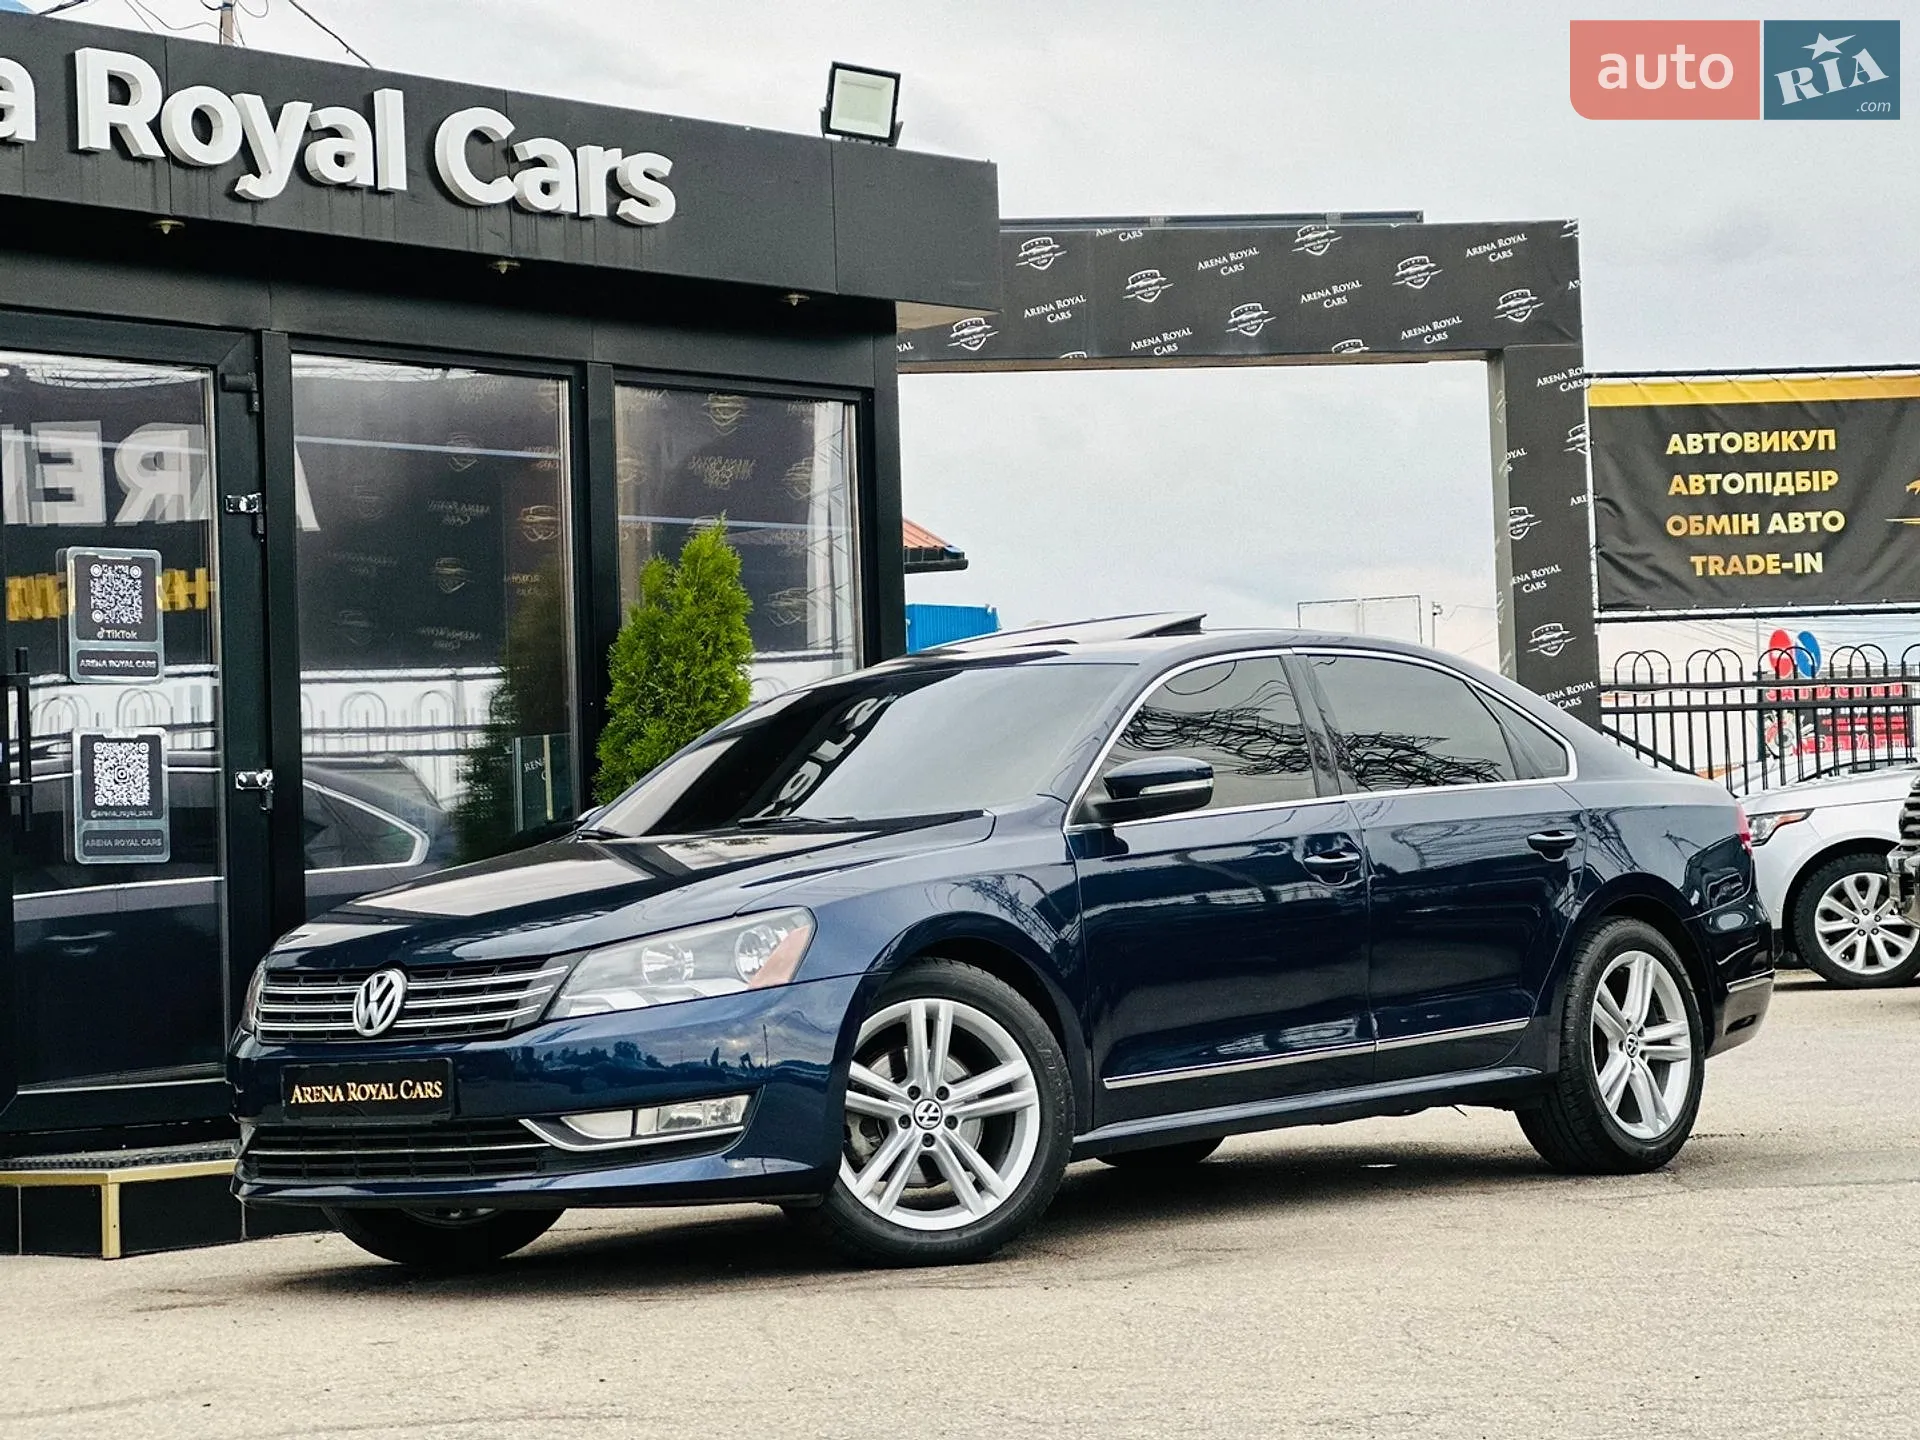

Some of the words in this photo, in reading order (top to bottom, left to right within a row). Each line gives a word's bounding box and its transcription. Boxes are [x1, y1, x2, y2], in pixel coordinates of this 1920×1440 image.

[75, 47, 407, 200] Royal
[434, 106, 676, 227] Cars
[1119, 228, 1143, 241] CARS
[1465, 242, 1497, 258] ARENA
[1498, 233, 1528, 248] ROYAL
[1197, 256, 1229, 271] ARENA
[1229, 246, 1260, 262] ROYAL
[1488, 249, 1513, 262] CARS
[1220, 262, 1245, 276] CARS
[1300, 289, 1332, 304] ARENA
[1332, 279, 1363, 295] ROYAL
[1024, 303, 1056, 319] ARENA
[1055, 294, 1087, 309] ROYAL
[1323, 295, 1348, 308] CARS
[1046, 310, 1072, 323] CARS
[1401, 324, 1432, 340] ARENA
[1432, 315, 1463, 331] ROYAL
[1130, 335, 1162, 351] ARENA
[1161, 327, 1193, 342] ROYAL
[1423, 331, 1448, 344] CARS
[1153, 342, 1178, 356] CARS
[1536, 371, 1568, 387] ARENA
[1665, 428, 1836, 455] АВТОВИКУП
[1667, 470, 1839, 496] АВТОПІДБІР
[1665, 512, 1761, 537] ОБМІН
[1766, 510, 1846, 535] АВТО
[1531, 564, 1562, 579] ROYAL
[1689, 551, 1824, 577] TRADE-IN
[1522, 580, 1548, 593] CARS
[105, 628, 138, 640] TikTok
[1565, 681, 1597, 696] ROYAL
[1557, 696, 1582, 710] CARS
[84, 838, 113, 848] ARENA
[114, 838, 140, 848] ROYAL
[141, 837, 162, 847] CARS
[290, 1084, 345, 1104] ARENA
[346, 1082, 398, 1101] ROYAL
[399, 1079, 443, 1099] CARS
